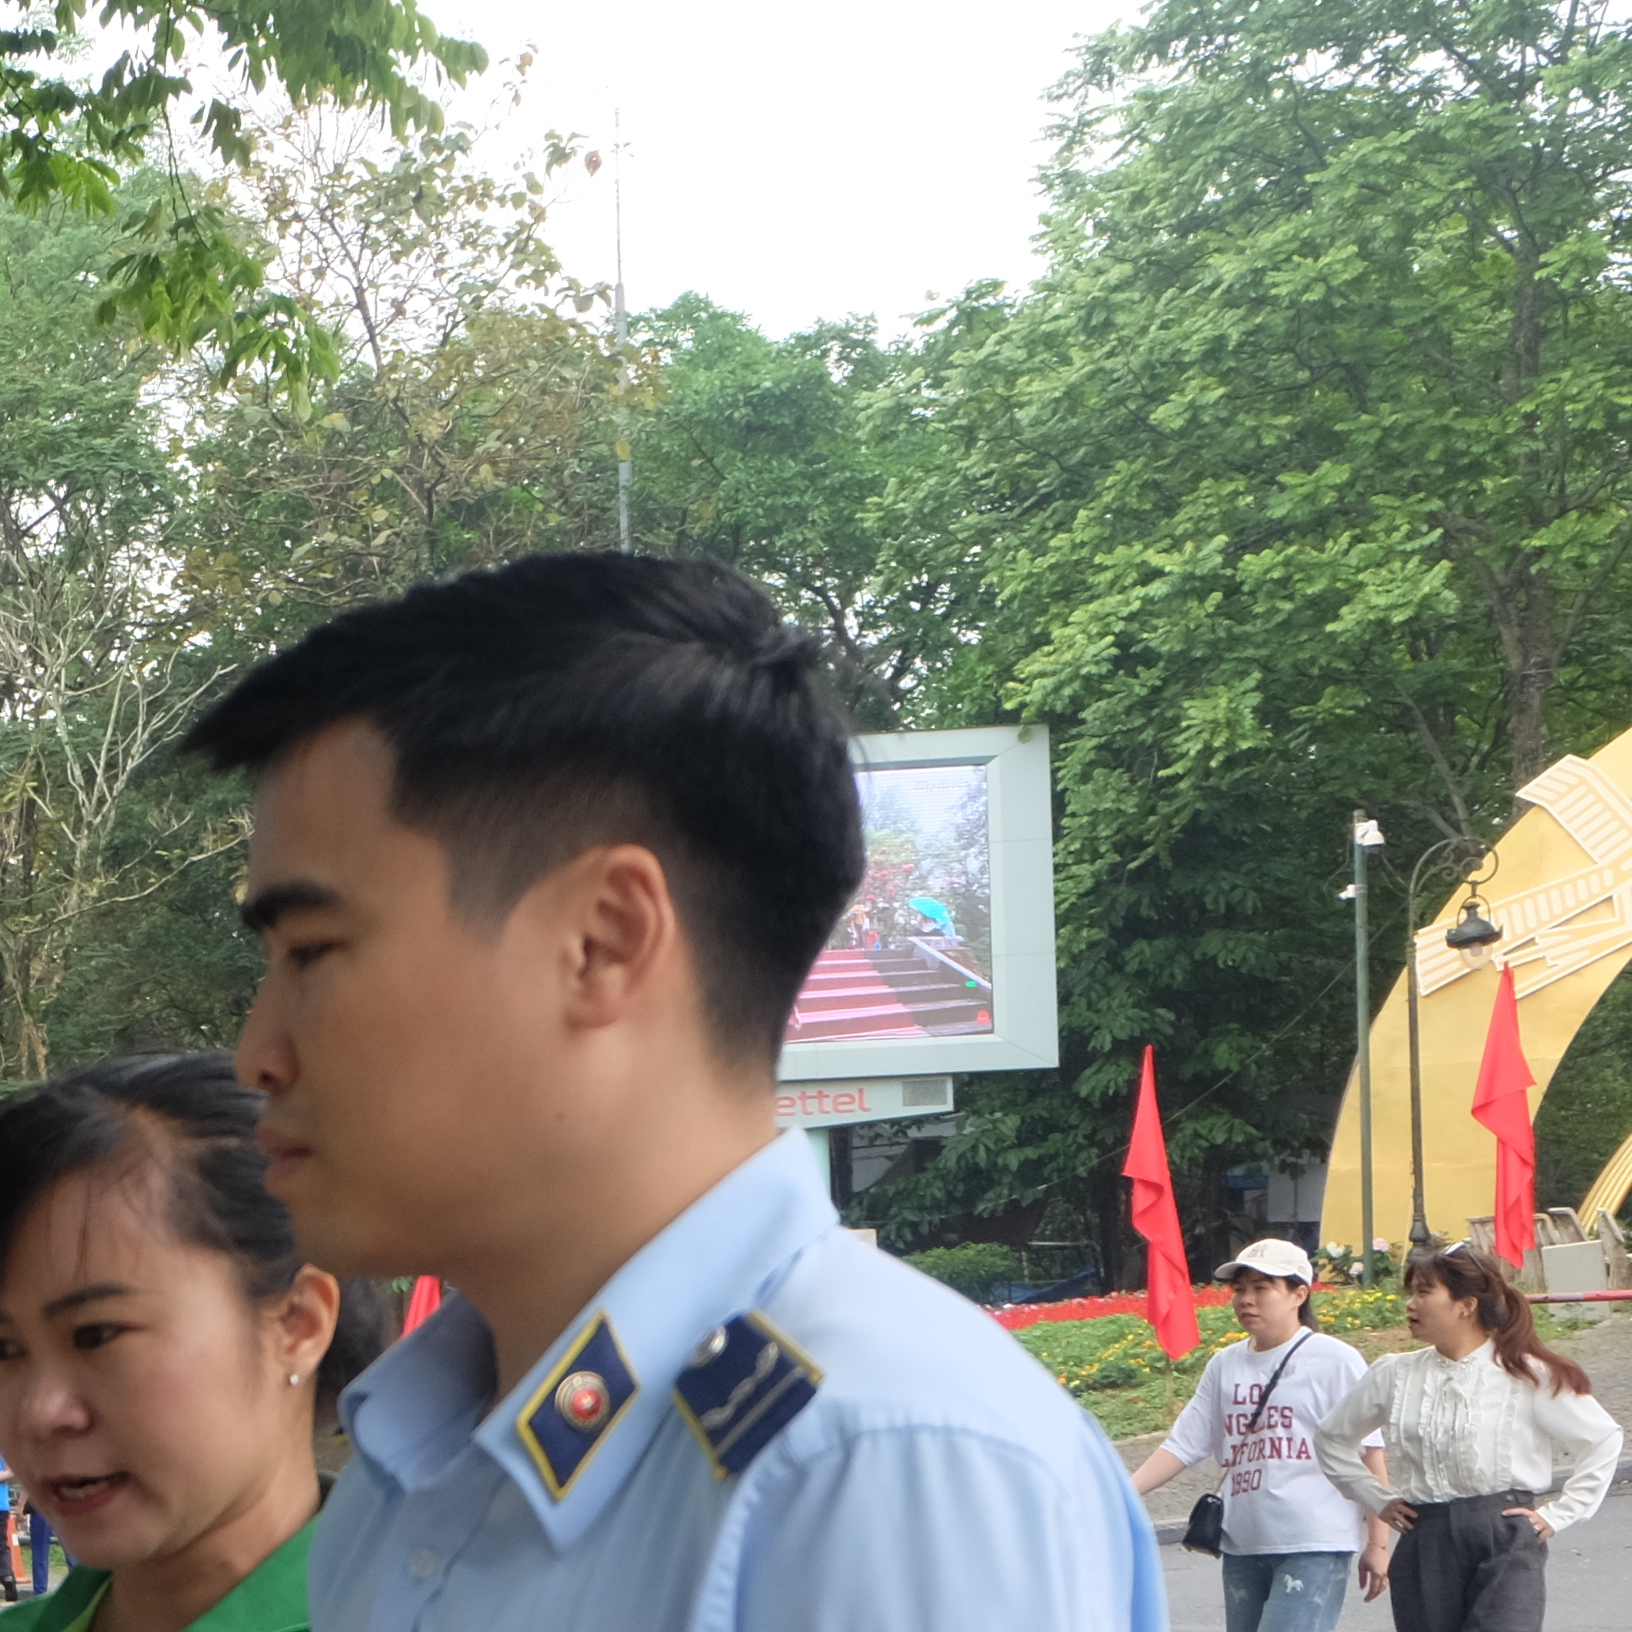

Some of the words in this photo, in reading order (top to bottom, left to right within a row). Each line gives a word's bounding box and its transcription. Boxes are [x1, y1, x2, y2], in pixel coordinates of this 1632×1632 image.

[776, 1088, 872, 1117] ettel
[1232, 1383, 1265, 1406] LO
[1231, 1469, 1262, 1497] 1990
